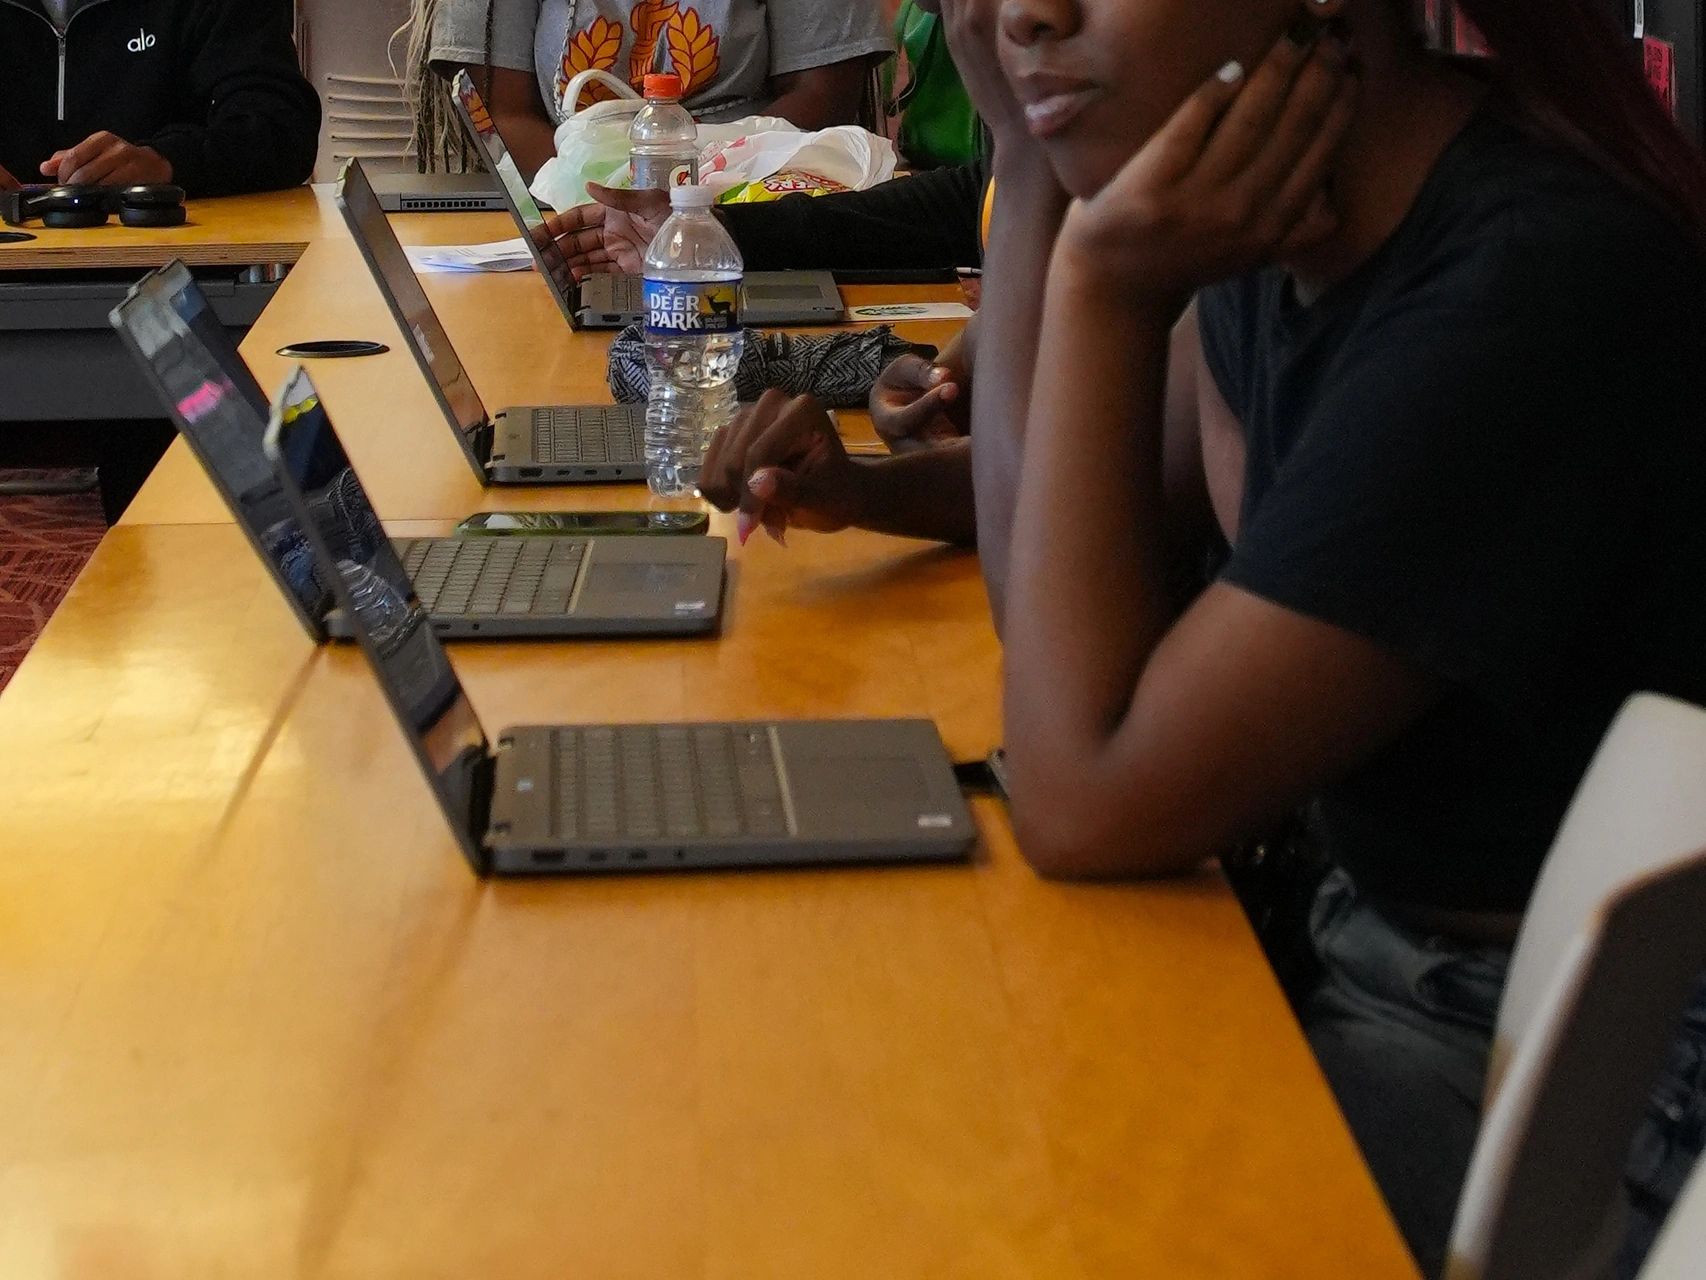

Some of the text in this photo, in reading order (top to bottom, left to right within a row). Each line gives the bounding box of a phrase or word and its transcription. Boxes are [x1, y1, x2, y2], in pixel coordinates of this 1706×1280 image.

[127, 27, 156, 52] alo
[650, 293, 700, 312] DEER
[650, 310, 701, 331] PARK
